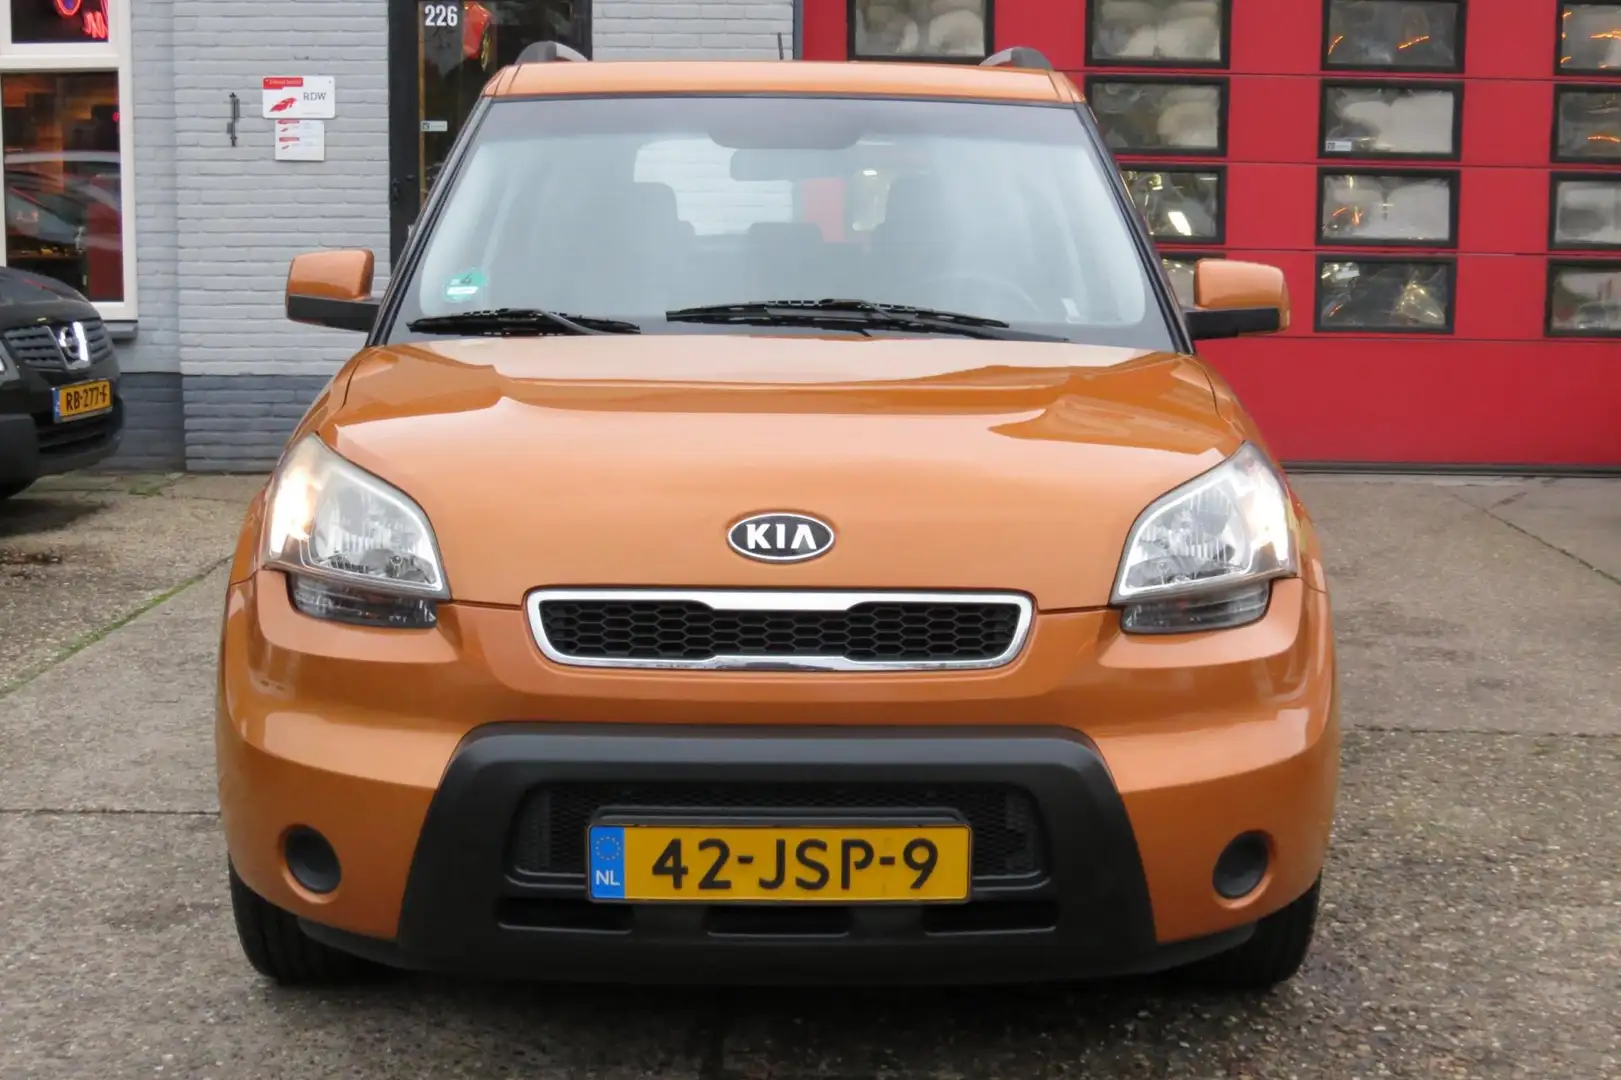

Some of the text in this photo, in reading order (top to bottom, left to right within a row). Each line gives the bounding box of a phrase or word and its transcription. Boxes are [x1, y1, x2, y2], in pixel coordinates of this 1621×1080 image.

[424, 4, 458, 27] 226
[303, 91, 327, 101] RDW
[746, 523, 817, 550] KIA
[651, 837, 939, 891] 42-JSP-9
[596, 869, 620, 886] NL
